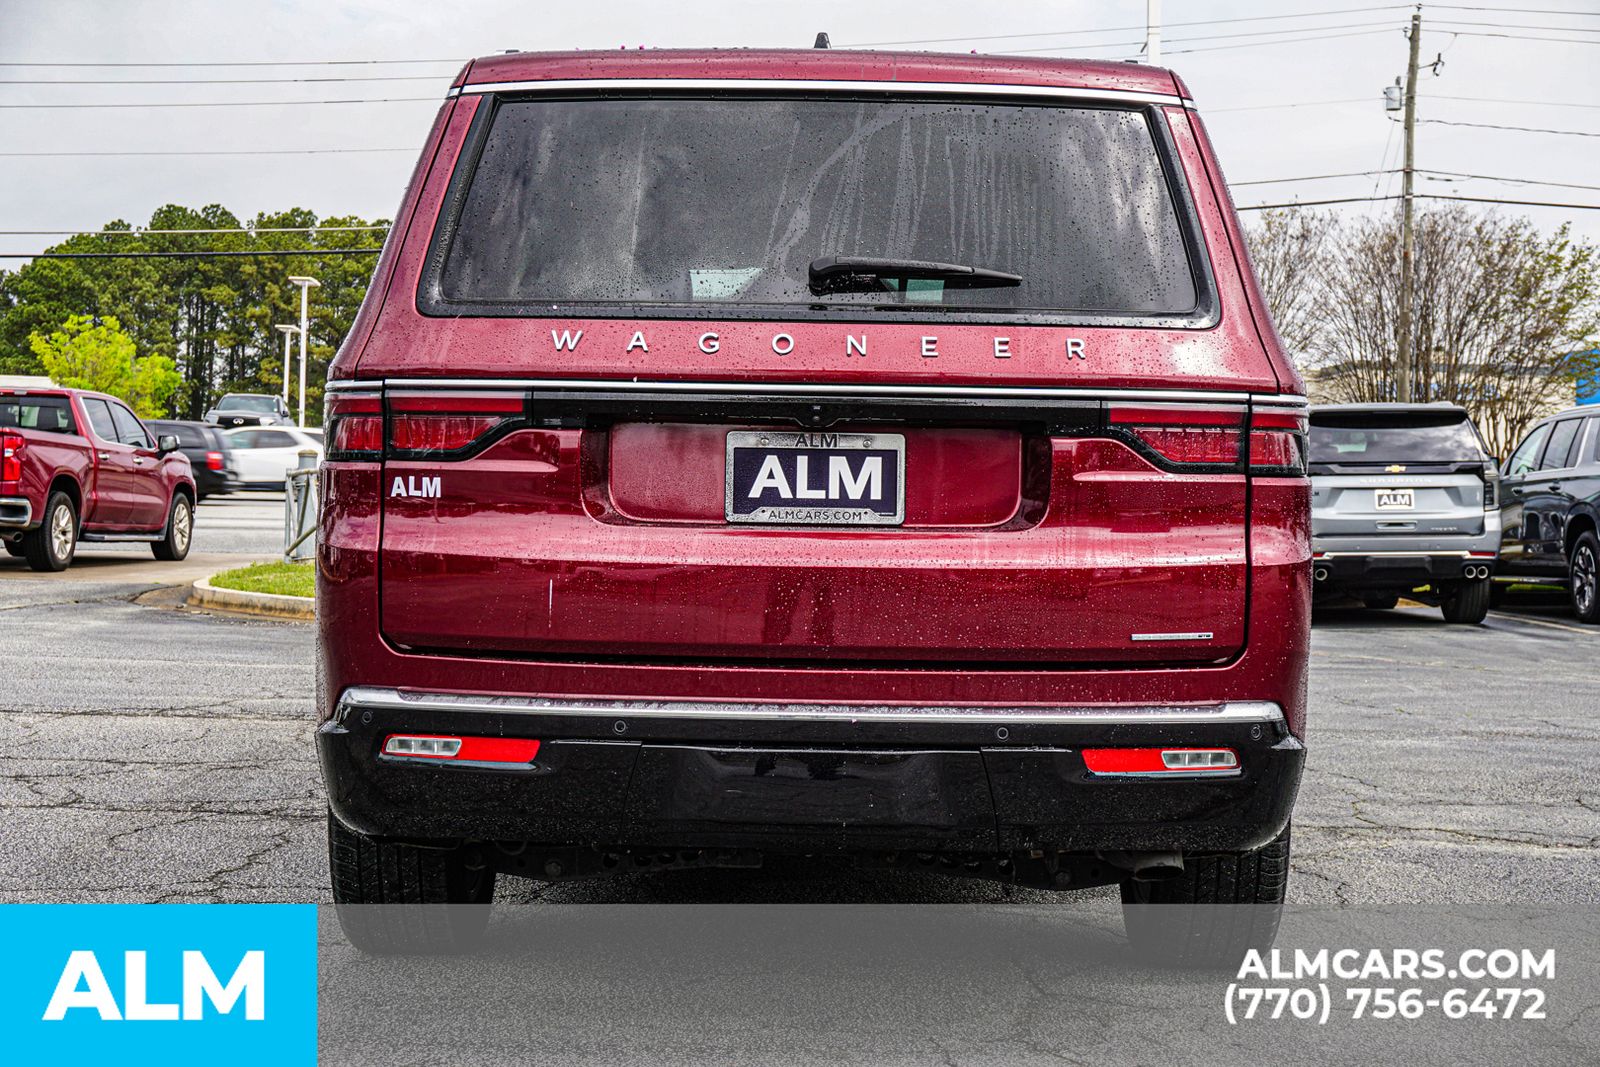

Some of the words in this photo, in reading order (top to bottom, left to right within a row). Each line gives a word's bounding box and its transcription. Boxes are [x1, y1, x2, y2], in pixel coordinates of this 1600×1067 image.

[551, 329, 1086, 359] WAGONEER
[795, 434, 839, 448] ALM
[748, 455, 883, 500] ALM
[390, 476, 442, 498] ALM
[1379, 494, 1410, 505] ALM
[768, 510, 862, 521] ALMCARS.COM
